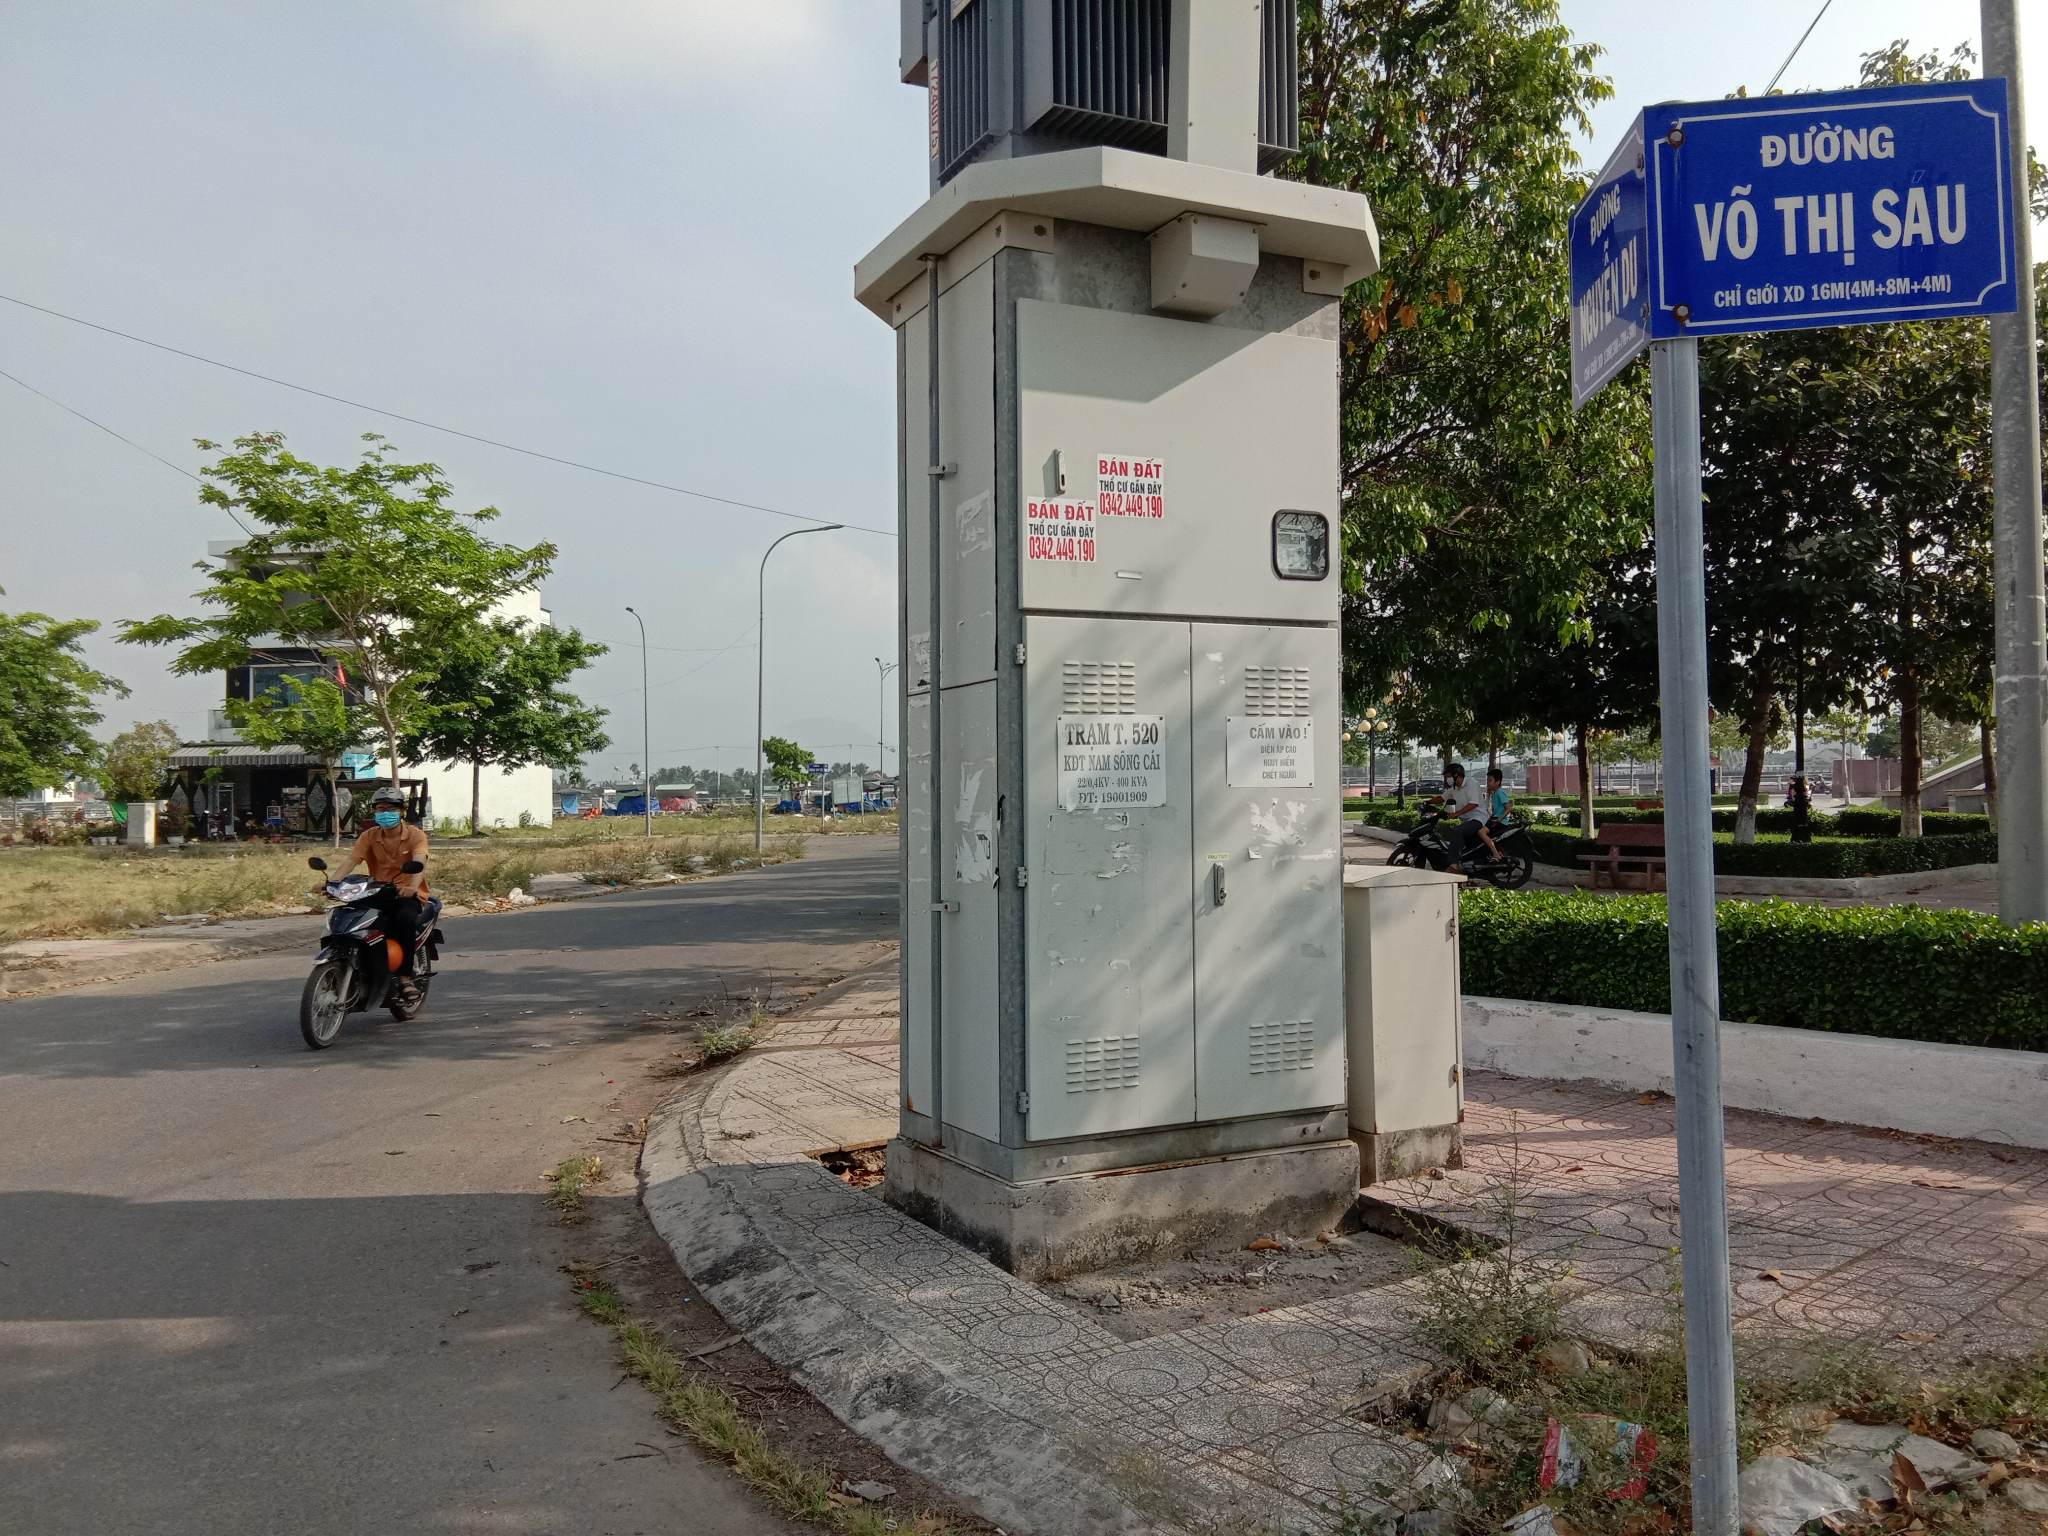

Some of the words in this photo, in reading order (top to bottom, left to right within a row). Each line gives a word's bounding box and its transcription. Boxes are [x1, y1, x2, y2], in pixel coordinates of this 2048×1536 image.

[1760, 122, 1895, 168] ĐƯỜNG
[1590, 183, 1621, 246] ĐƯỜNG
[1694, 184, 1759, 262] VÕ
[1774, 192, 1856, 266] THỊ
[1871, 169, 1968, 250] SÁU
[1579, 239, 1619, 352] NGUYỄN
[1621, 236, 1638, 308] DU
[1714, 284, 1742, 308] CHỈ
[1746, 282, 1778, 305] GIỚI
[1783, 285, 1805, 303] XD
[1811, 273, 1952, 302] 16M(4M+8M+4M)
[1099, 457, 1129, 477] BÁN
[1134, 458, 1162, 479] ĐẤT
[1117, 480, 1128, 493] CƯ
[1147, 482, 1162, 495] ĐÂY
[1028, 499, 1059, 520] BÁN
[1064, 500, 1094, 521] ĐẤT
[1100, 492, 1163, 519] 0342.449.190
[1079, 524, 1094, 538] ĐÂY
[1029, 536, 1095, 562] 0342.449.190
[1065, 722, 1110, 751] TRẠM
[1132, 722, 1159, 745] 520
[1249, 722, 1275, 739] CẤM
[1278, 724, 1301, 739] VÀO
[1285, 745, 1297, 754] CAO
[1064, 755, 1086, 772] KĐT
[1088, 755, 1111, 772] NAM
[1113, 750, 1140, 771] SÔNG
[1143, 750, 1161, 770] CÁI
[1116, 777, 1129, 788] 400
[1131, 777, 1148, 788] KVA
[1078, 792, 1098, 804] ĐT:
[1102, 791, 1148, 803] 19001909
